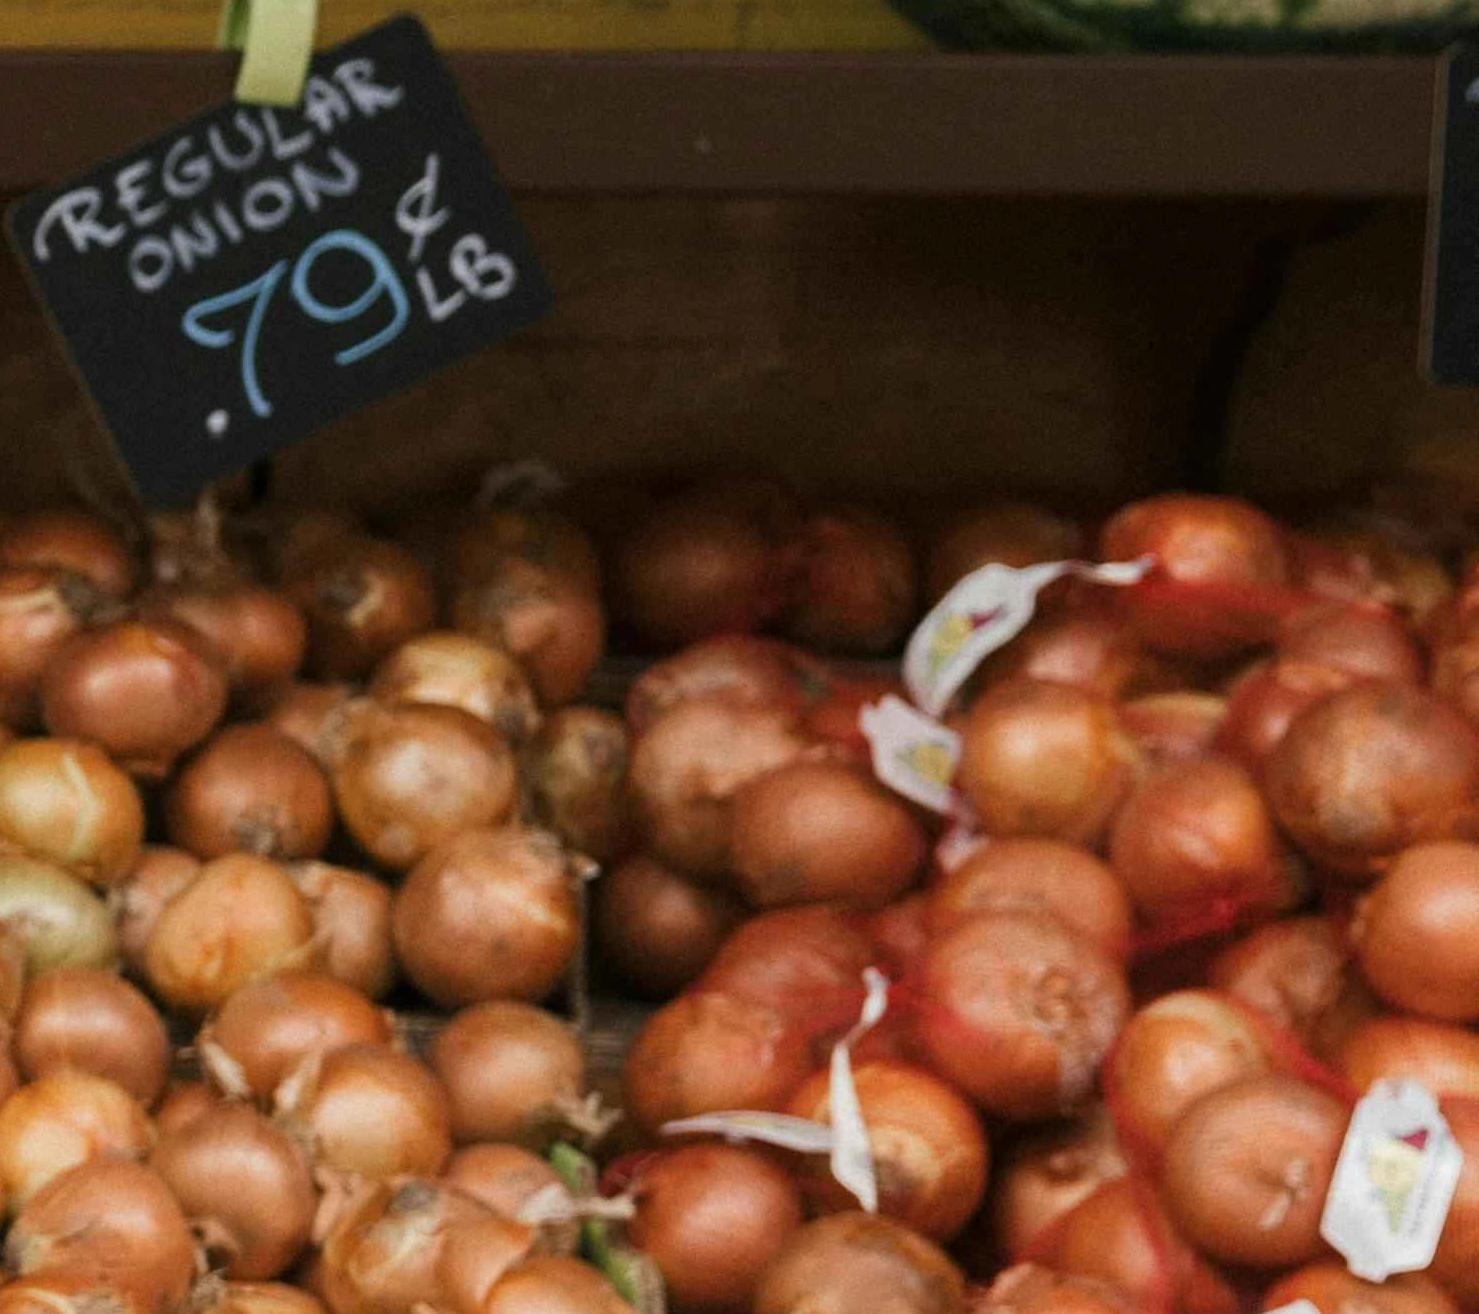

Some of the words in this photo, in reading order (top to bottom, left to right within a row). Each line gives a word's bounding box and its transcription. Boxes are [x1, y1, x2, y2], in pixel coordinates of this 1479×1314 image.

[33, 58, 402, 261] REGULAR
[128, 146, 361, 292] ONION
[181, 229, 410, 439] .79
[417, 233, 517, 323] LB
